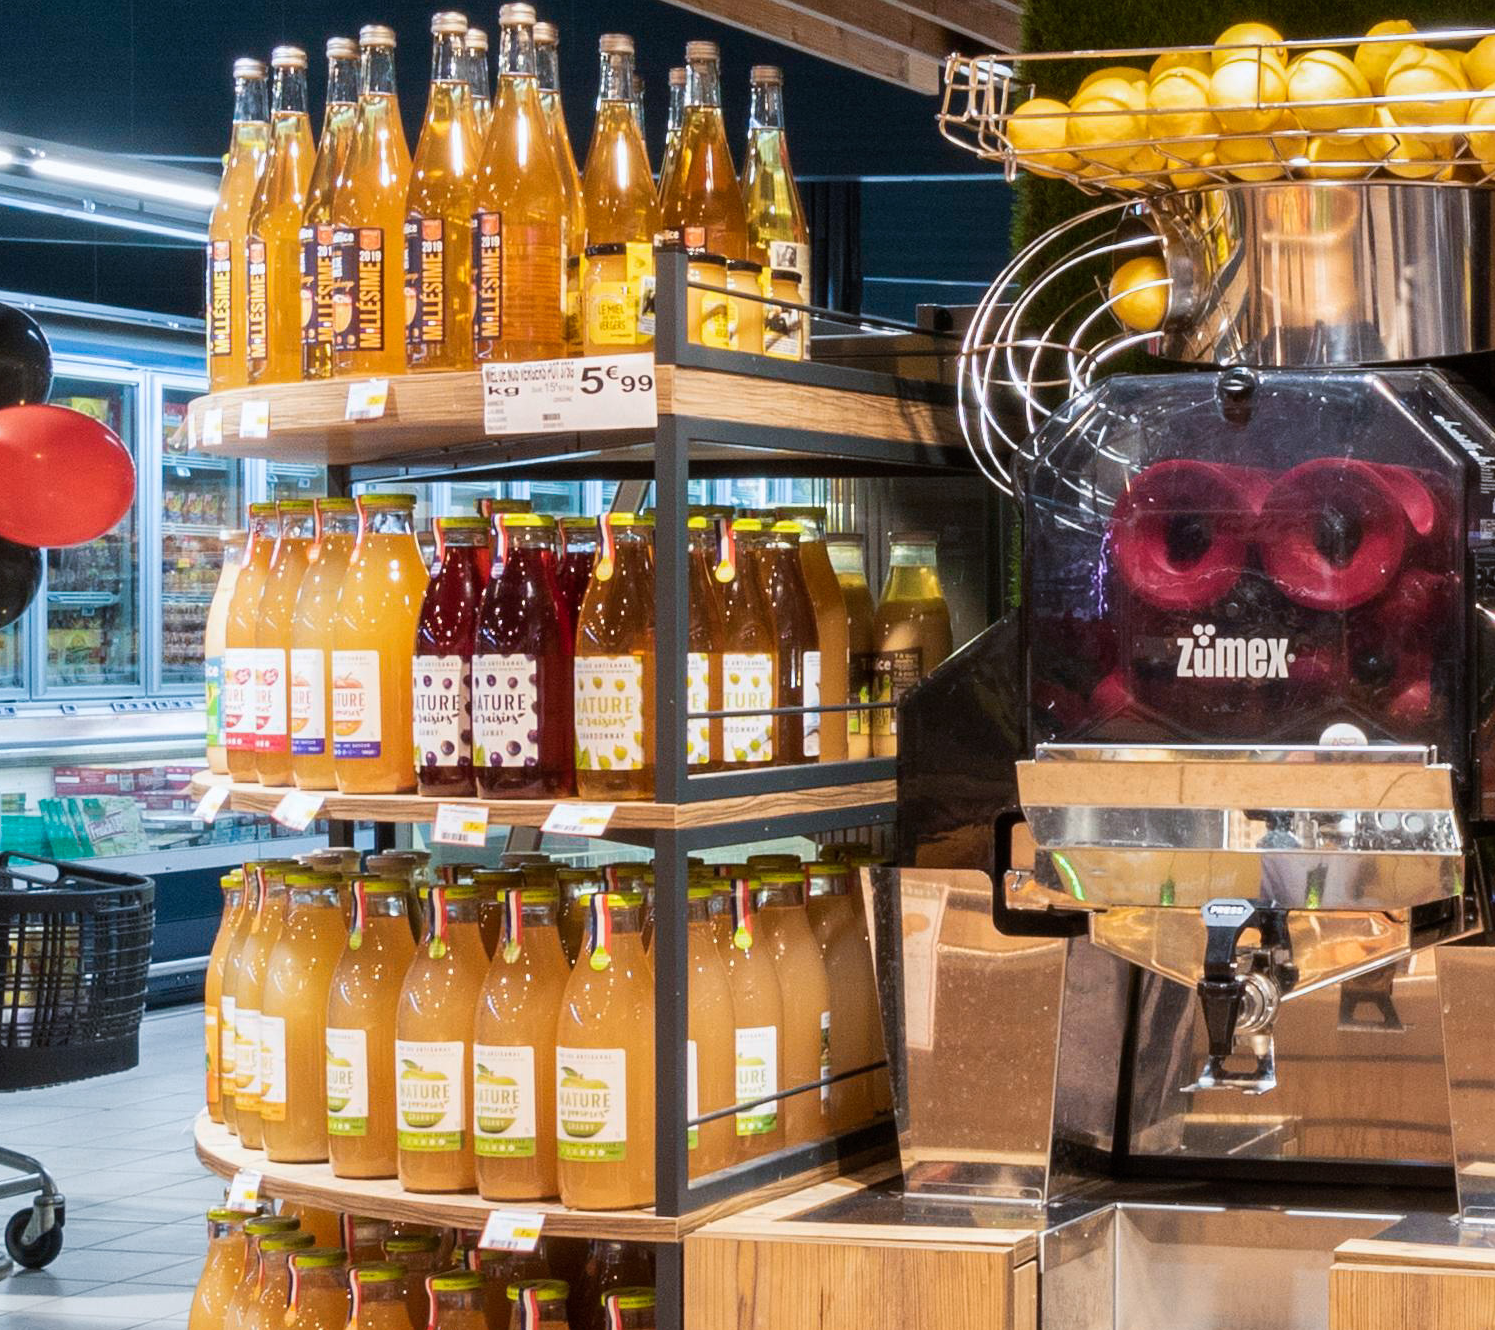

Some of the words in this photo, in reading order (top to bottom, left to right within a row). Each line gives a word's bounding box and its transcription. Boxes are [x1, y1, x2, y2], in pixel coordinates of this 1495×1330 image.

[422, 241, 443, 253] 2019
[481, 236, 500, 248] 2019
[359, 250, 382, 262] 2019
